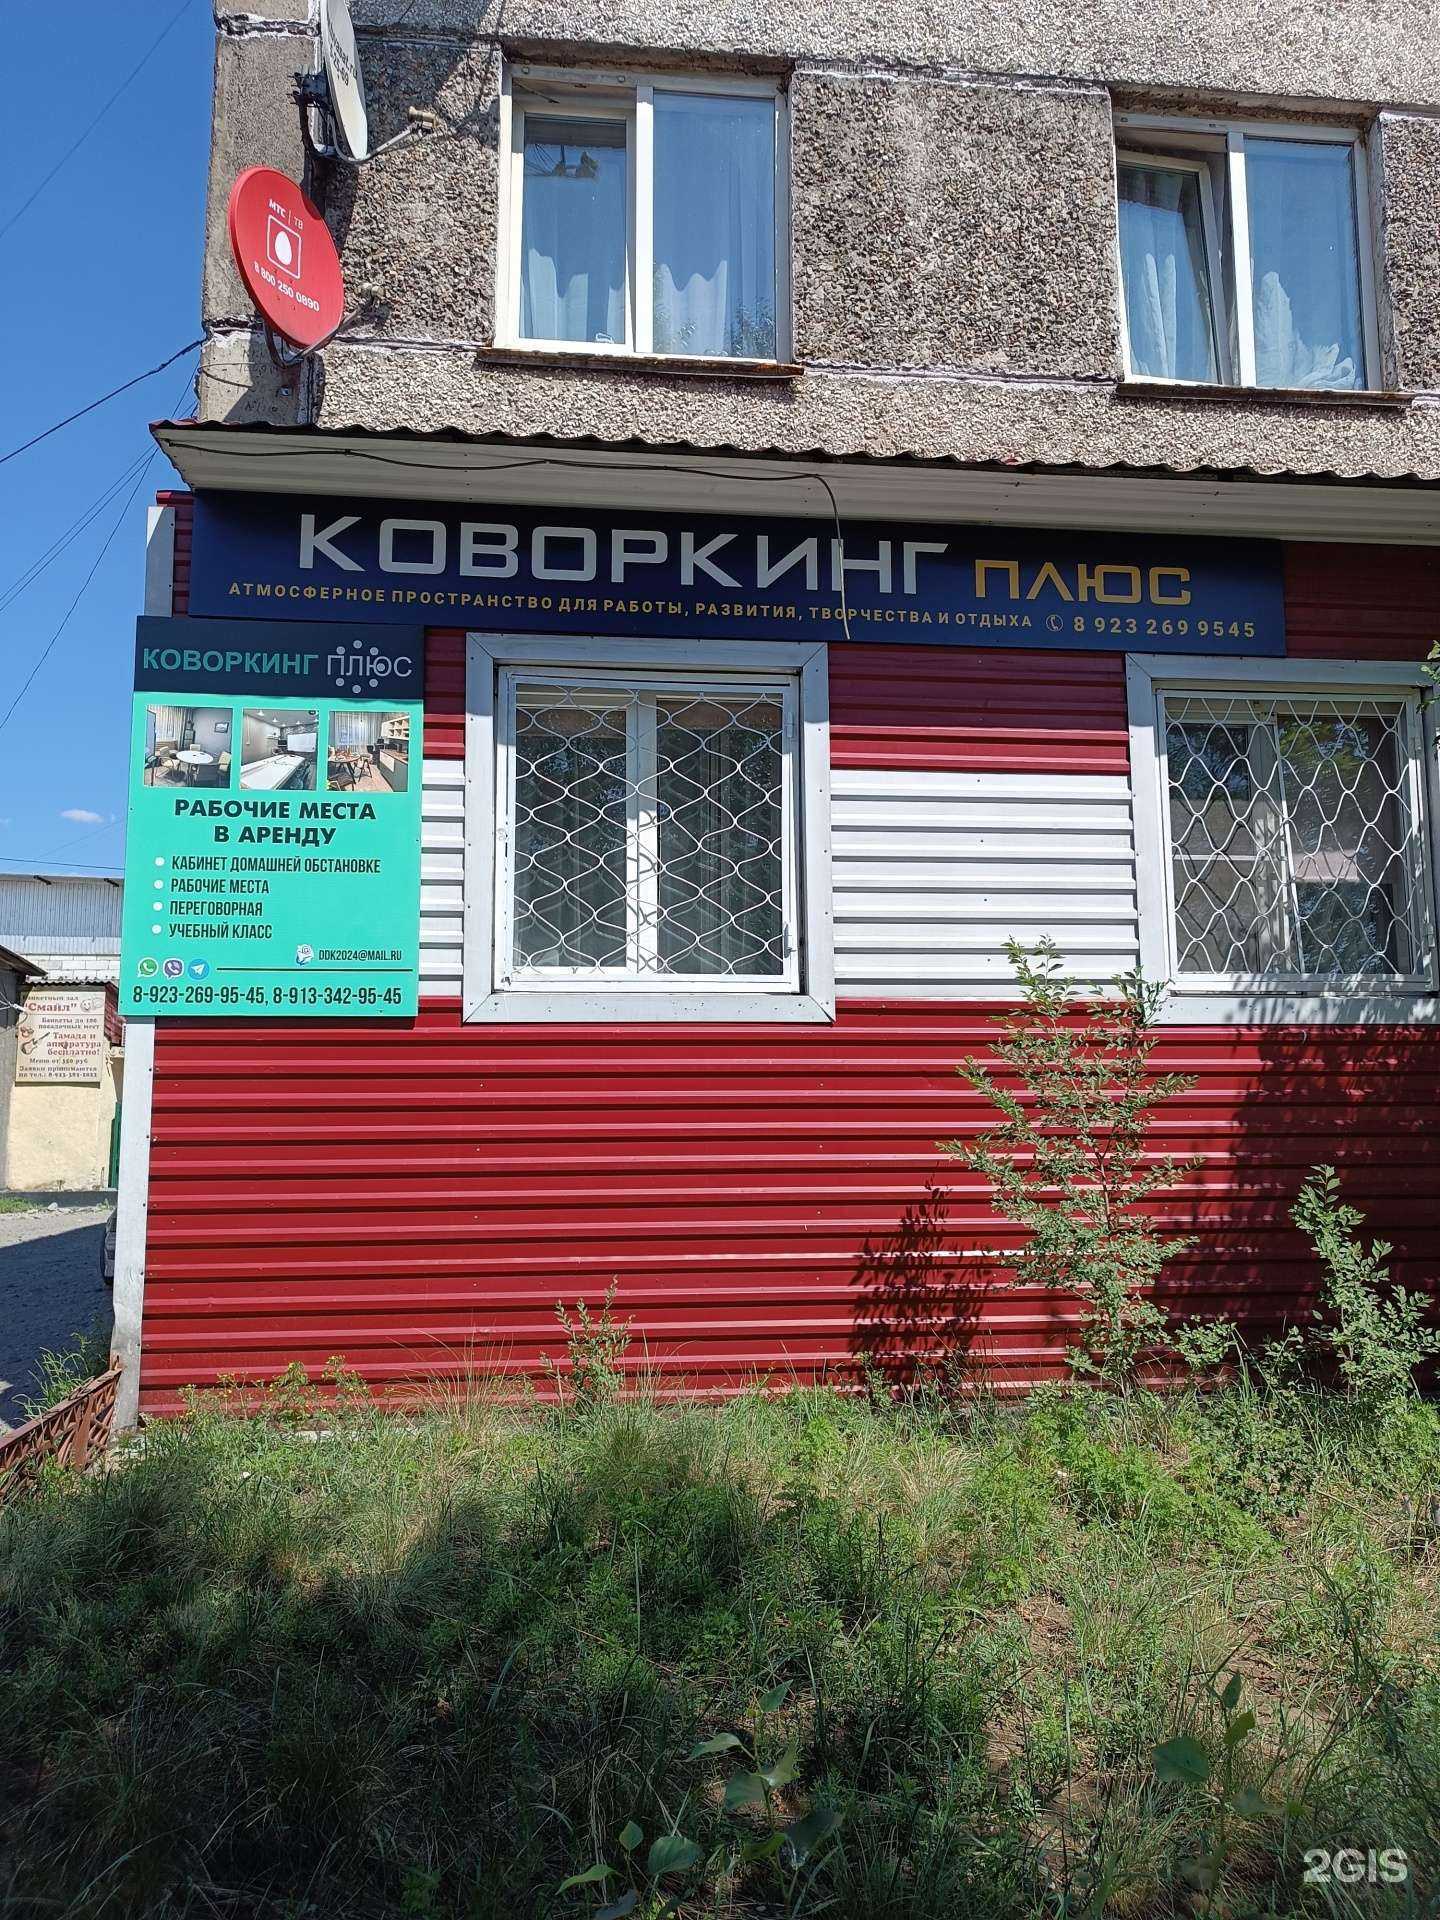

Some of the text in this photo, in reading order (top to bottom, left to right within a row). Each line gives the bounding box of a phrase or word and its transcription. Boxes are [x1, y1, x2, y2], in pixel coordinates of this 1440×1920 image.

[268, 199, 286, 219] МТС
[260, 268, 276, 287] 800
[278, 281, 294, 298] 250
[295, 291, 320, 312] 0890
[299, 513, 1192, 605] КОВОРКИНГ ПЛЮС
[229, 582, 1033, 628] АТМОСФЕРНОЕ ПРОСТРАНСТВО ДЛЯ РАБОТЫ, РАЗВИТИЯ, ТВОРЧЕСТВА И ОТДЫХА
[1073, 616, 1256, 638] 8 923 269 9545
[142, 648, 413, 677] КОВОРКИНГ ПЛЮС
[174, 798, 377, 820] РАБОЧИЕ МЕСТА
[214, 825, 337, 847] В АРЕНДУ
[171, 855, 381, 874] КАБИНЕТ ДОМАШНЕЙ ОБСТАНОВКЕ
[170, 878, 270, 895] РАБОЧИЕ МЕСТА
[169, 900, 264, 917] ПЕРЕГОВОРНАЯ
[168, 920, 273, 939] УЧЕБНЫЙ КЛАСС
[318, 949, 402, 961] DDK2024@MAIL.RU
[133, 985, 401, 1006] 8-923-269-95-45, 8-913-342-95-45
